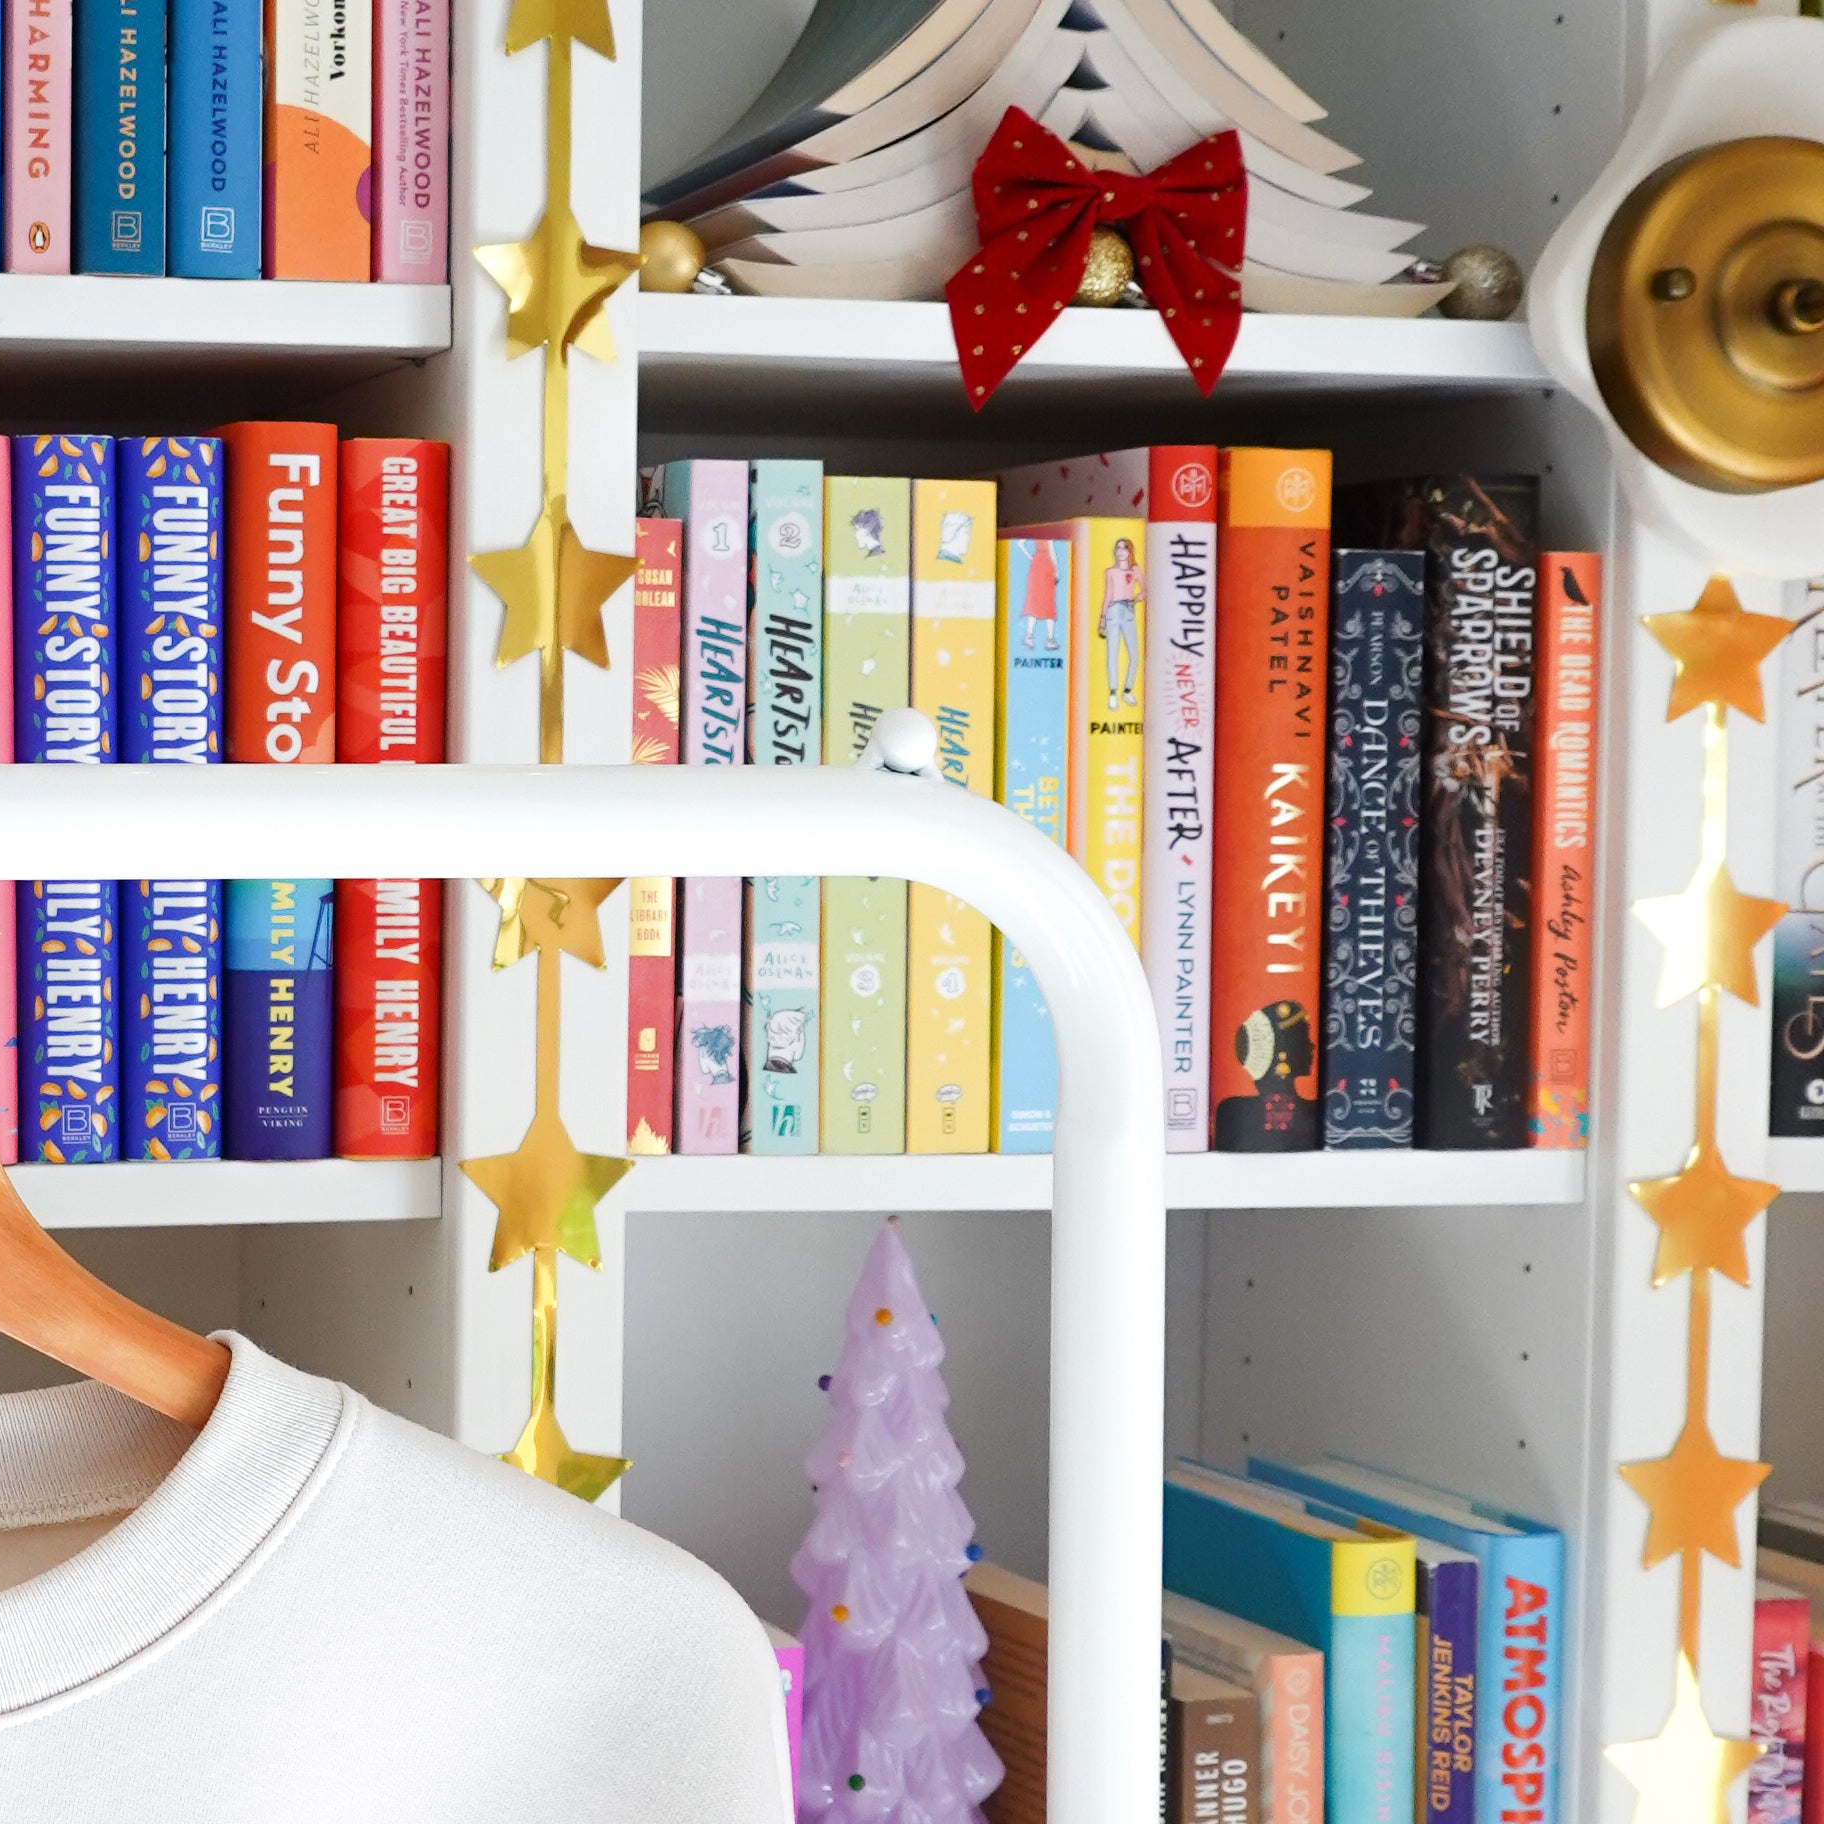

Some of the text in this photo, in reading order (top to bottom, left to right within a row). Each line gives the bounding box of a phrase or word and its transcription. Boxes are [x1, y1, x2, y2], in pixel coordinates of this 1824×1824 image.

[209, 0, 228, 193] ALI HAZELWOOD
[43, 484, 101, 764] FUNNY STORY
[250, 452, 321, 645] Funny
[380, 456, 416, 752] GREAT BIG BEAUTIFUL
[1448, 548, 1497, 747] SPARROWS
[1493, 564, 1537, 701] SHIELD
[1166, 533, 1207, 849] HAPPILY NEVER AFTER
[1550, 656, 1589, 849] DEAD ROMANTICS
[1261, 763, 1308, 975] KAIKEYI
